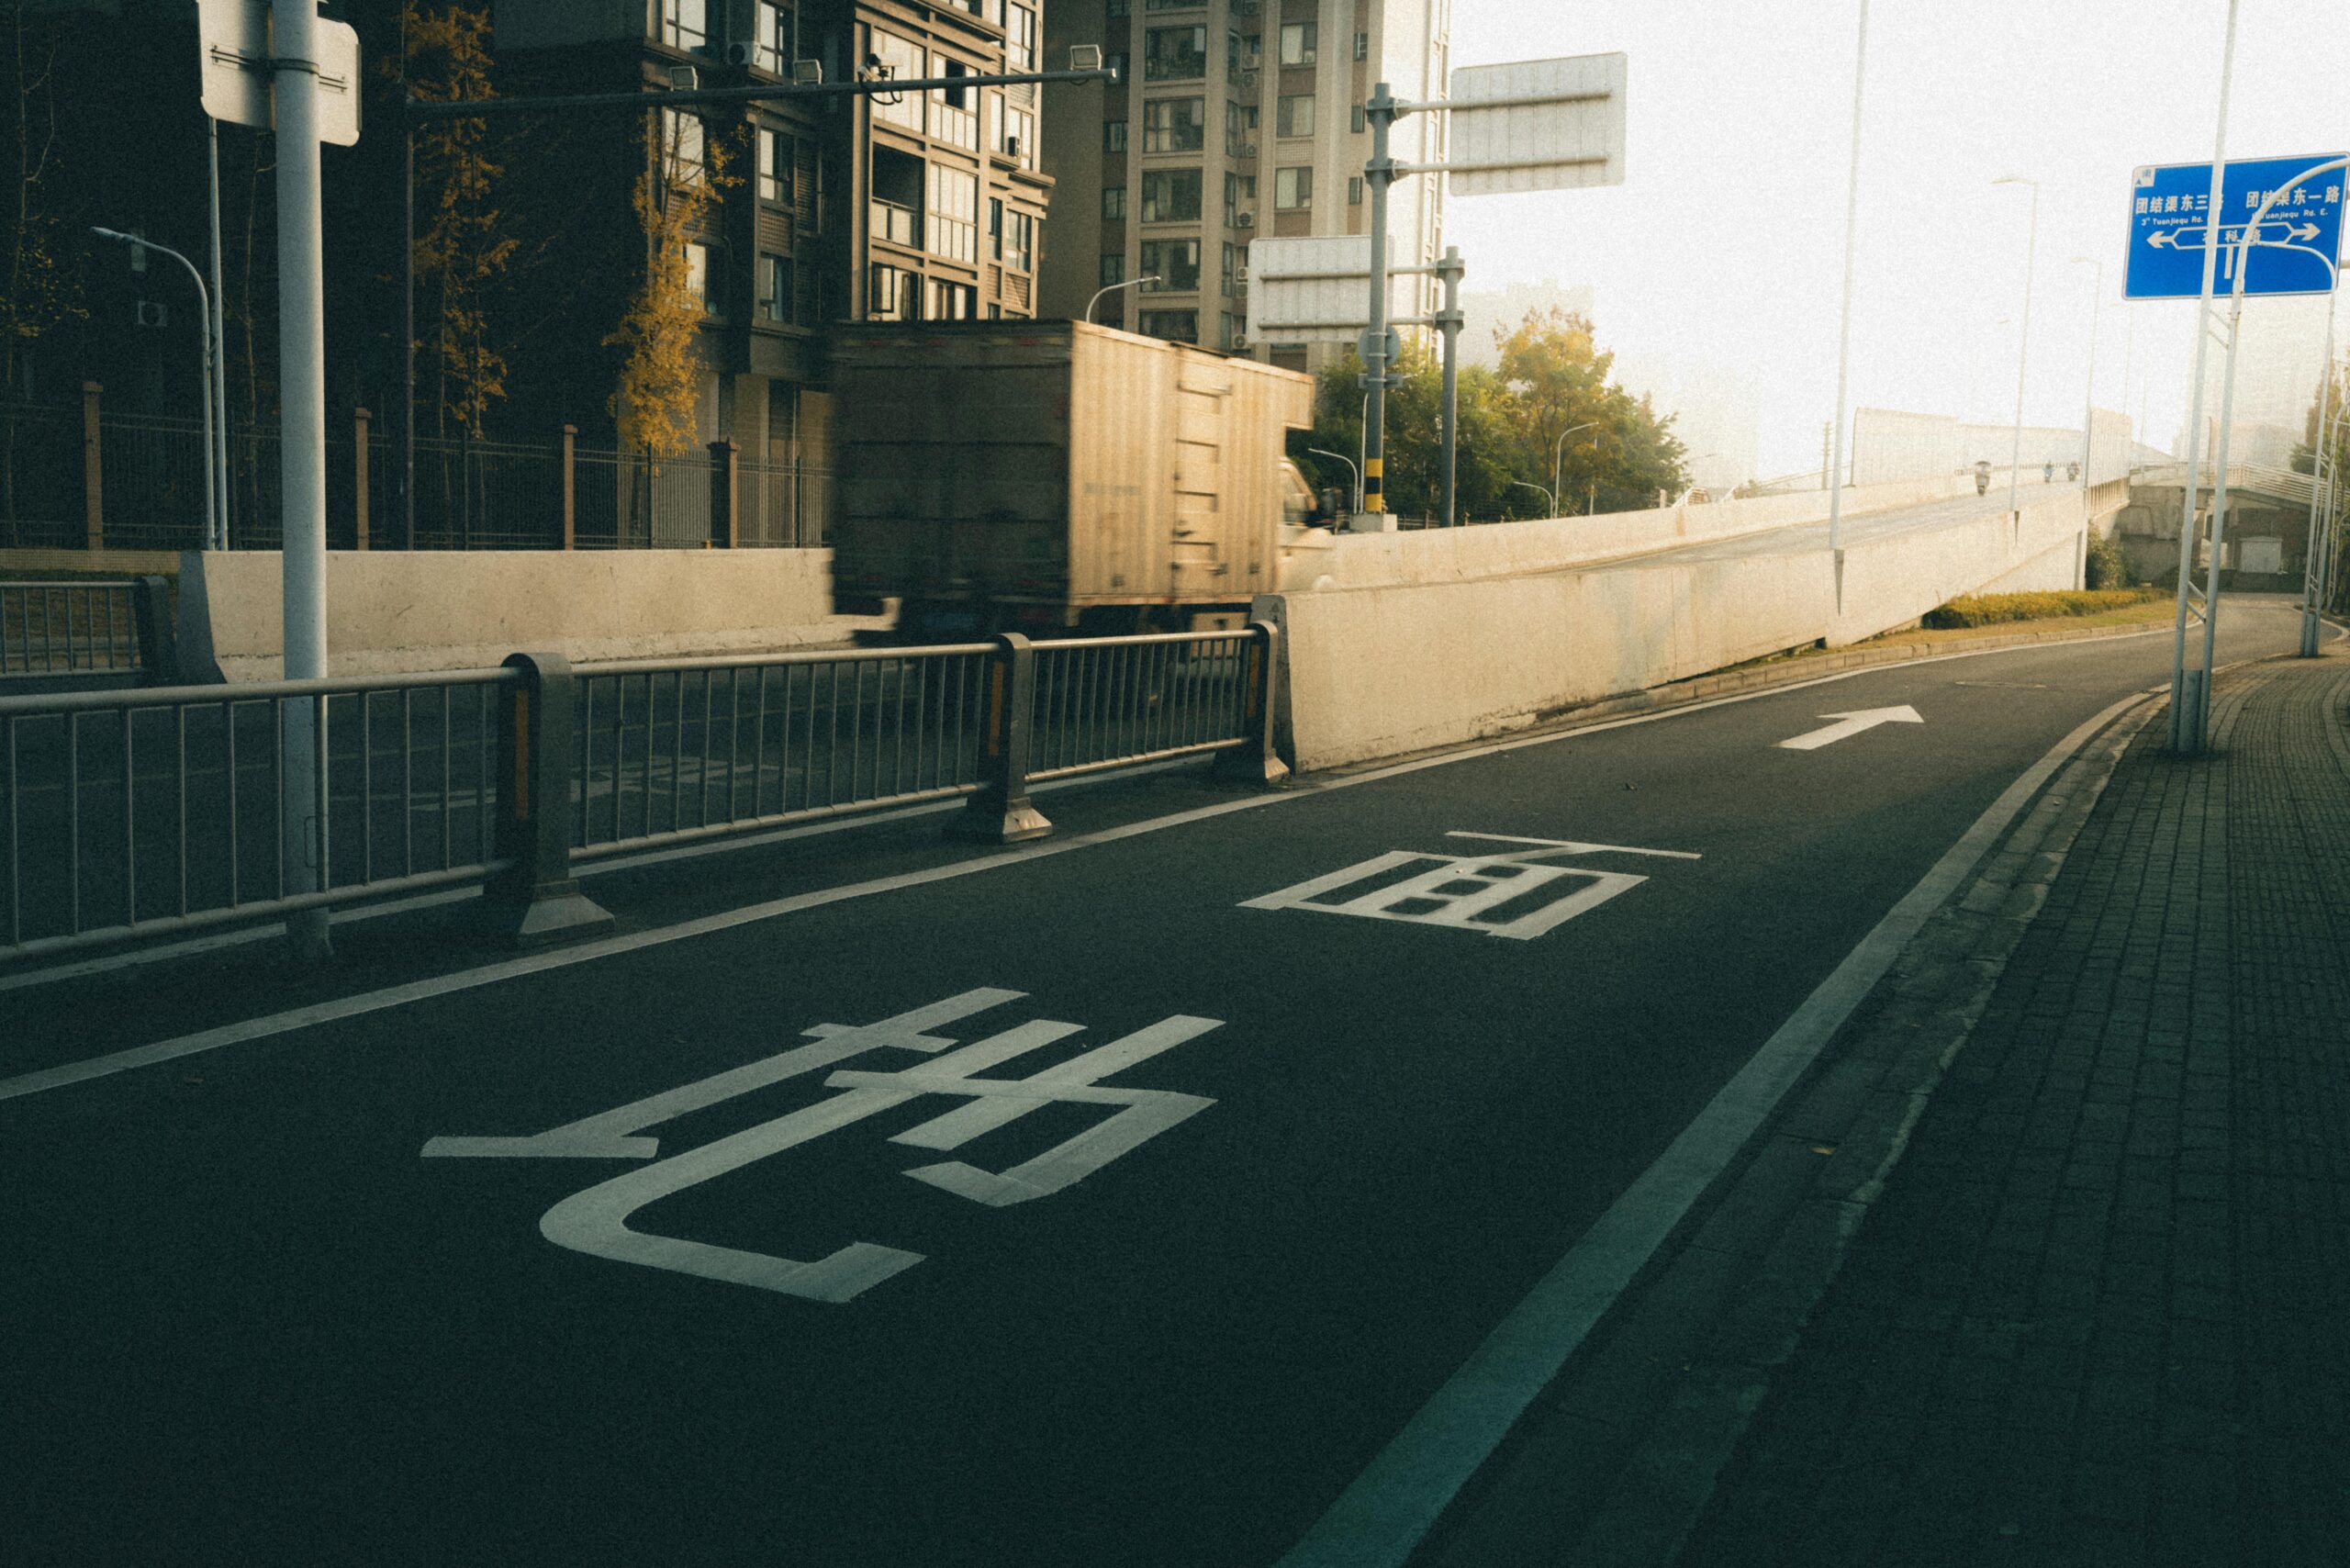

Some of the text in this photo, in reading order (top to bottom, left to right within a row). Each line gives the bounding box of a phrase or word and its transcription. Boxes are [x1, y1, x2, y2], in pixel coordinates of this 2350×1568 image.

[2135, 194, 2223, 215] 团结渠东三
[2320, 207, 2329, 216] E.
